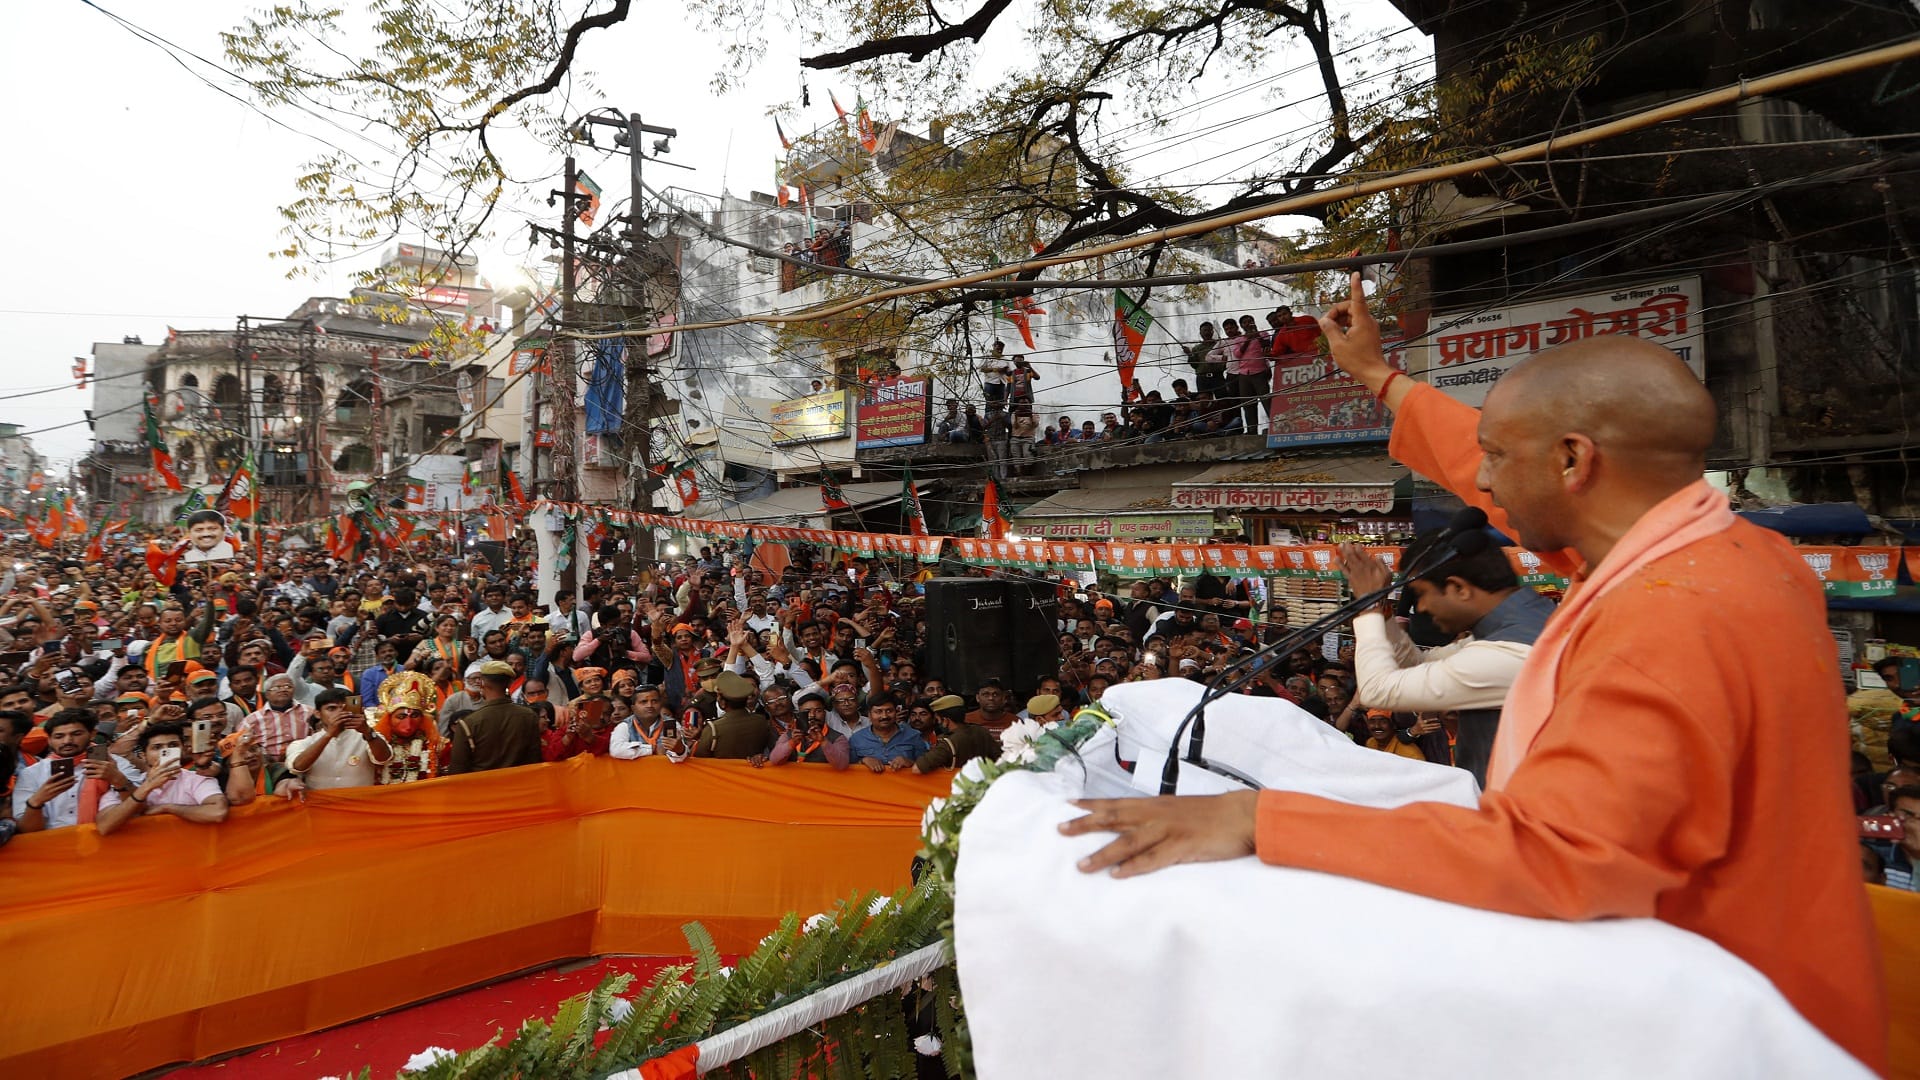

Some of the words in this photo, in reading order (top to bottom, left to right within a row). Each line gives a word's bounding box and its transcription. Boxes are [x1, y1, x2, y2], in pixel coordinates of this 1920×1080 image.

[1437, 323, 1541, 366] प्रयाग
[1281, 357, 1328, 385] लक्ष्मी
[897, 380, 924, 400] किराना
[1225, 487, 1282, 507] किराना
[1286, 488, 1330, 507] स्टोर
[1020, 524, 1047, 536] जय
[1050, 523, 1089, 536] माता
[1093, 517, 1113, 536] दी
[1119, 523, 1137, 533] एण्ड
[1139, 519, 1172, 533] कम्पनी
[1861, 581, 1896, 591] B.J.P.
